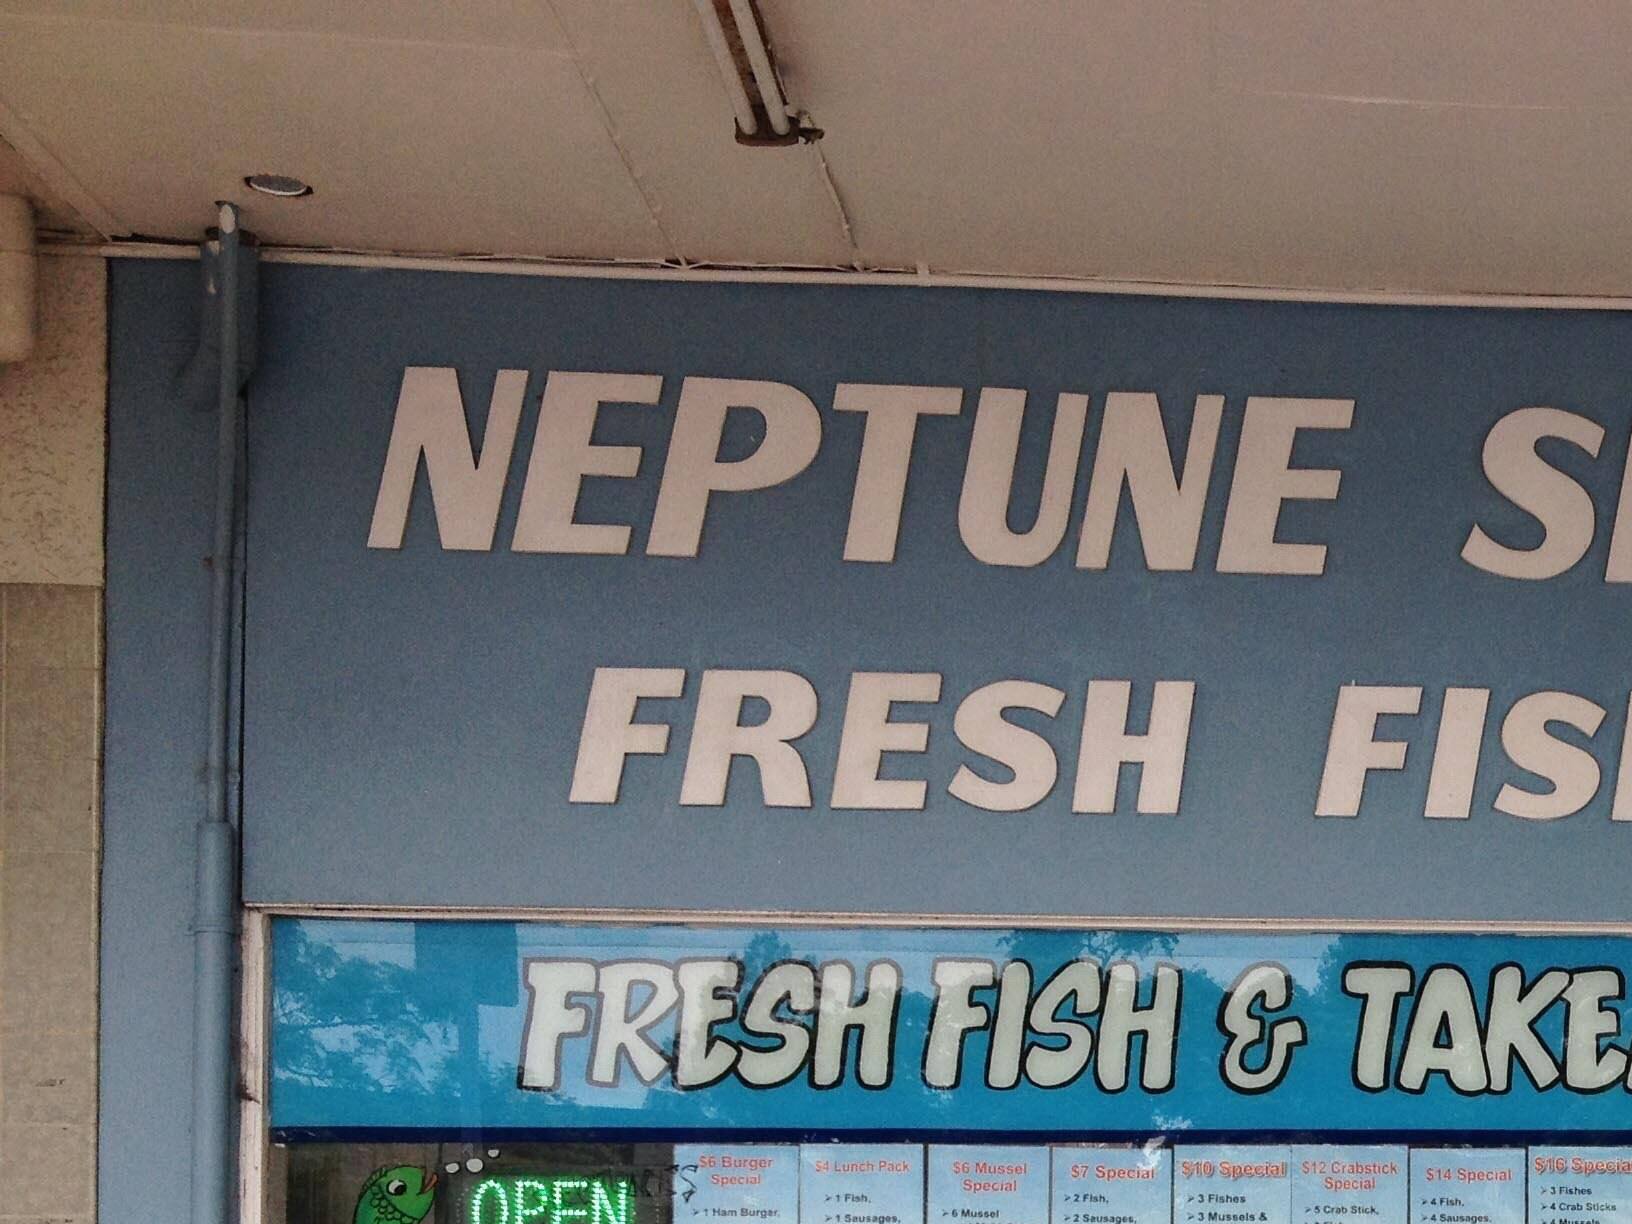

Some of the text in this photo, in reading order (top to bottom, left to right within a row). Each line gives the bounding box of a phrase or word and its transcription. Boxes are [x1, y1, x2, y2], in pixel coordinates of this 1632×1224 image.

[366, 363, 1357, 579] NEPTUNE
[567, 663, 1201, 818] FRESH
[517, 957, 900, 1091] FRESH
[919, 957, 1181, 1093] FISH
[1218, 957, 1308, 1097] &
[699, 1155, 774, 1171] $6 Burger
[815, 1160, 910, 1172] $4 Lunch Pack
[952, 1161, 1027, 1174] $6 Mussel
[1301, 1161, 1398, 1174] $12 Crabstick
[1071, 1164, 1155, 1181] $7 Special
[1219, 1161, 1288, 1180] Special
[1426, 1167, 1512, 1183] $14 Special
[711, 1174, 760, 1187] Special
[963, 1179, 1017, 1193] Special
[1323, 1177, 1375, 1192] Special
[1558, 1186, 1592, 1194] Fishes
[1207, 1194, 1246, 1203] Fishes
[712, 1208, 737, 1216] Ham
[1323, 1205, 1348, 1214] Crab
[1558, 1202, 1583, 1211] Crab
[1585, 1202, 1616, 1211] Sticks
[961, 1209, 999, 1218] Mussel
[1207, 1212, 1255, 1221] Mussels
[1258, 1211, 1268, 1221] &
